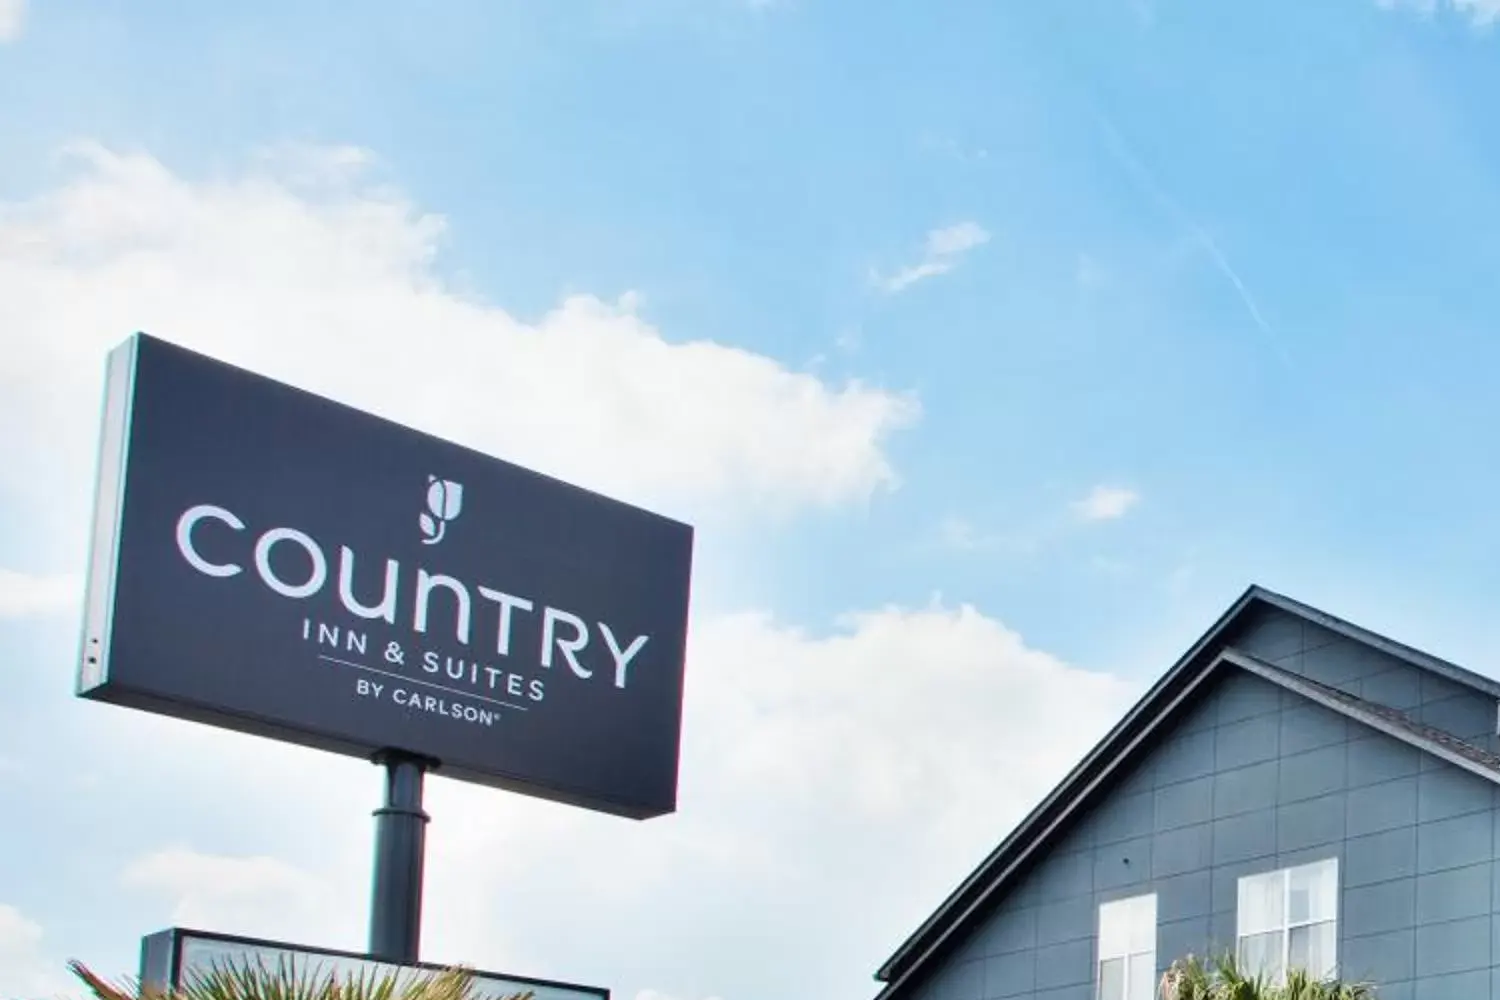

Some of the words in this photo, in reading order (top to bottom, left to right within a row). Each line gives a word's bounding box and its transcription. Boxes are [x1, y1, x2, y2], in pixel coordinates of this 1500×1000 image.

[303, 618, 367, 655] INN
[384, 641, 405, 665] &
[422, 651, 545, 702] SUITES
[356, 679, 385, 699] BY
